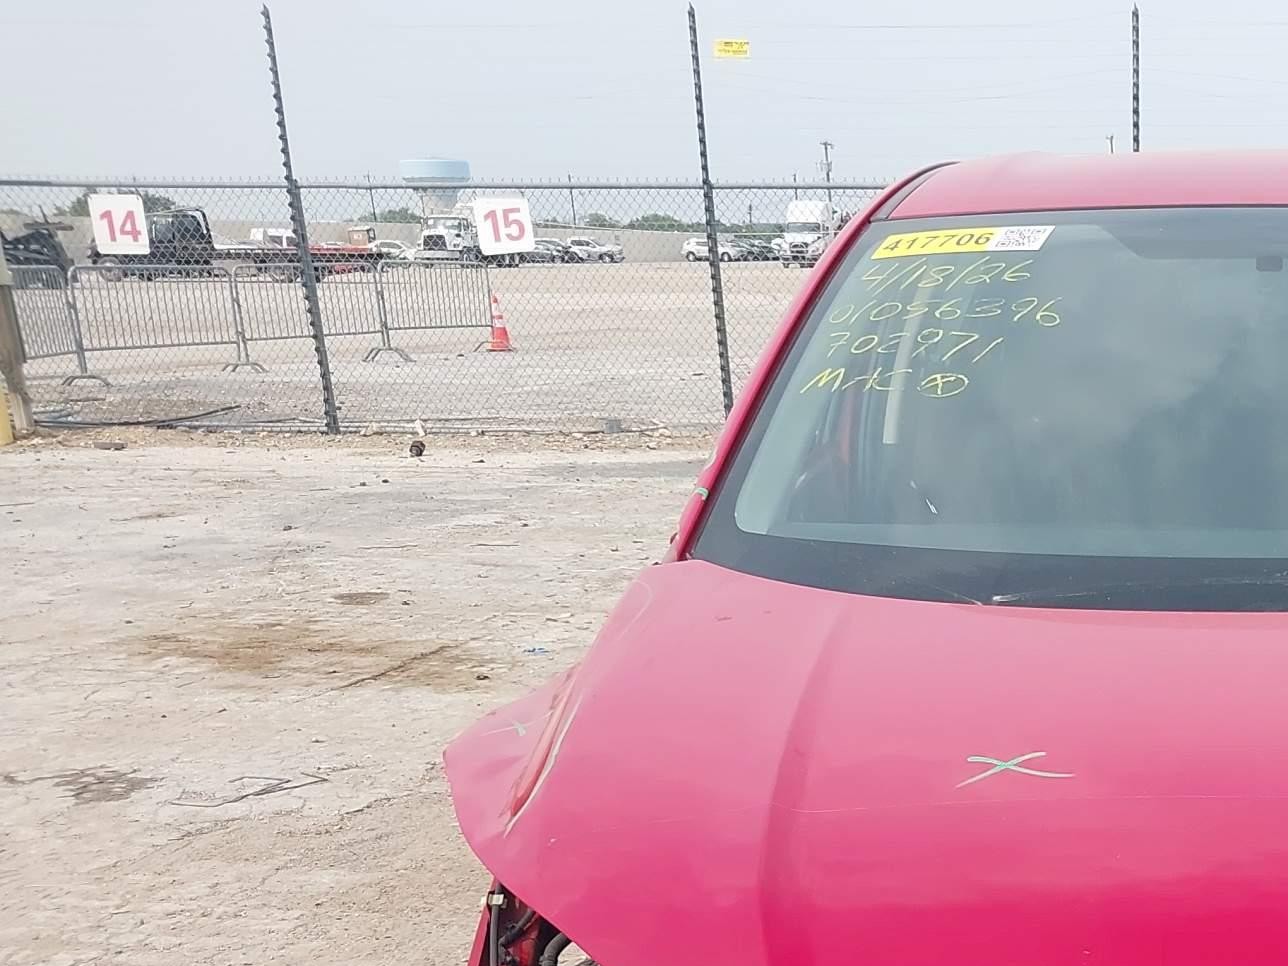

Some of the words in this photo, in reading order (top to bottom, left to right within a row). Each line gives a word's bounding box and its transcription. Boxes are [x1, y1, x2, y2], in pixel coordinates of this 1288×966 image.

[99, 210, 142, 242] 14
[483, 208, 525, 243] 15
[883, 232, 995, 252] 417706
[861, 256, 1034, 297] 4/18/26
